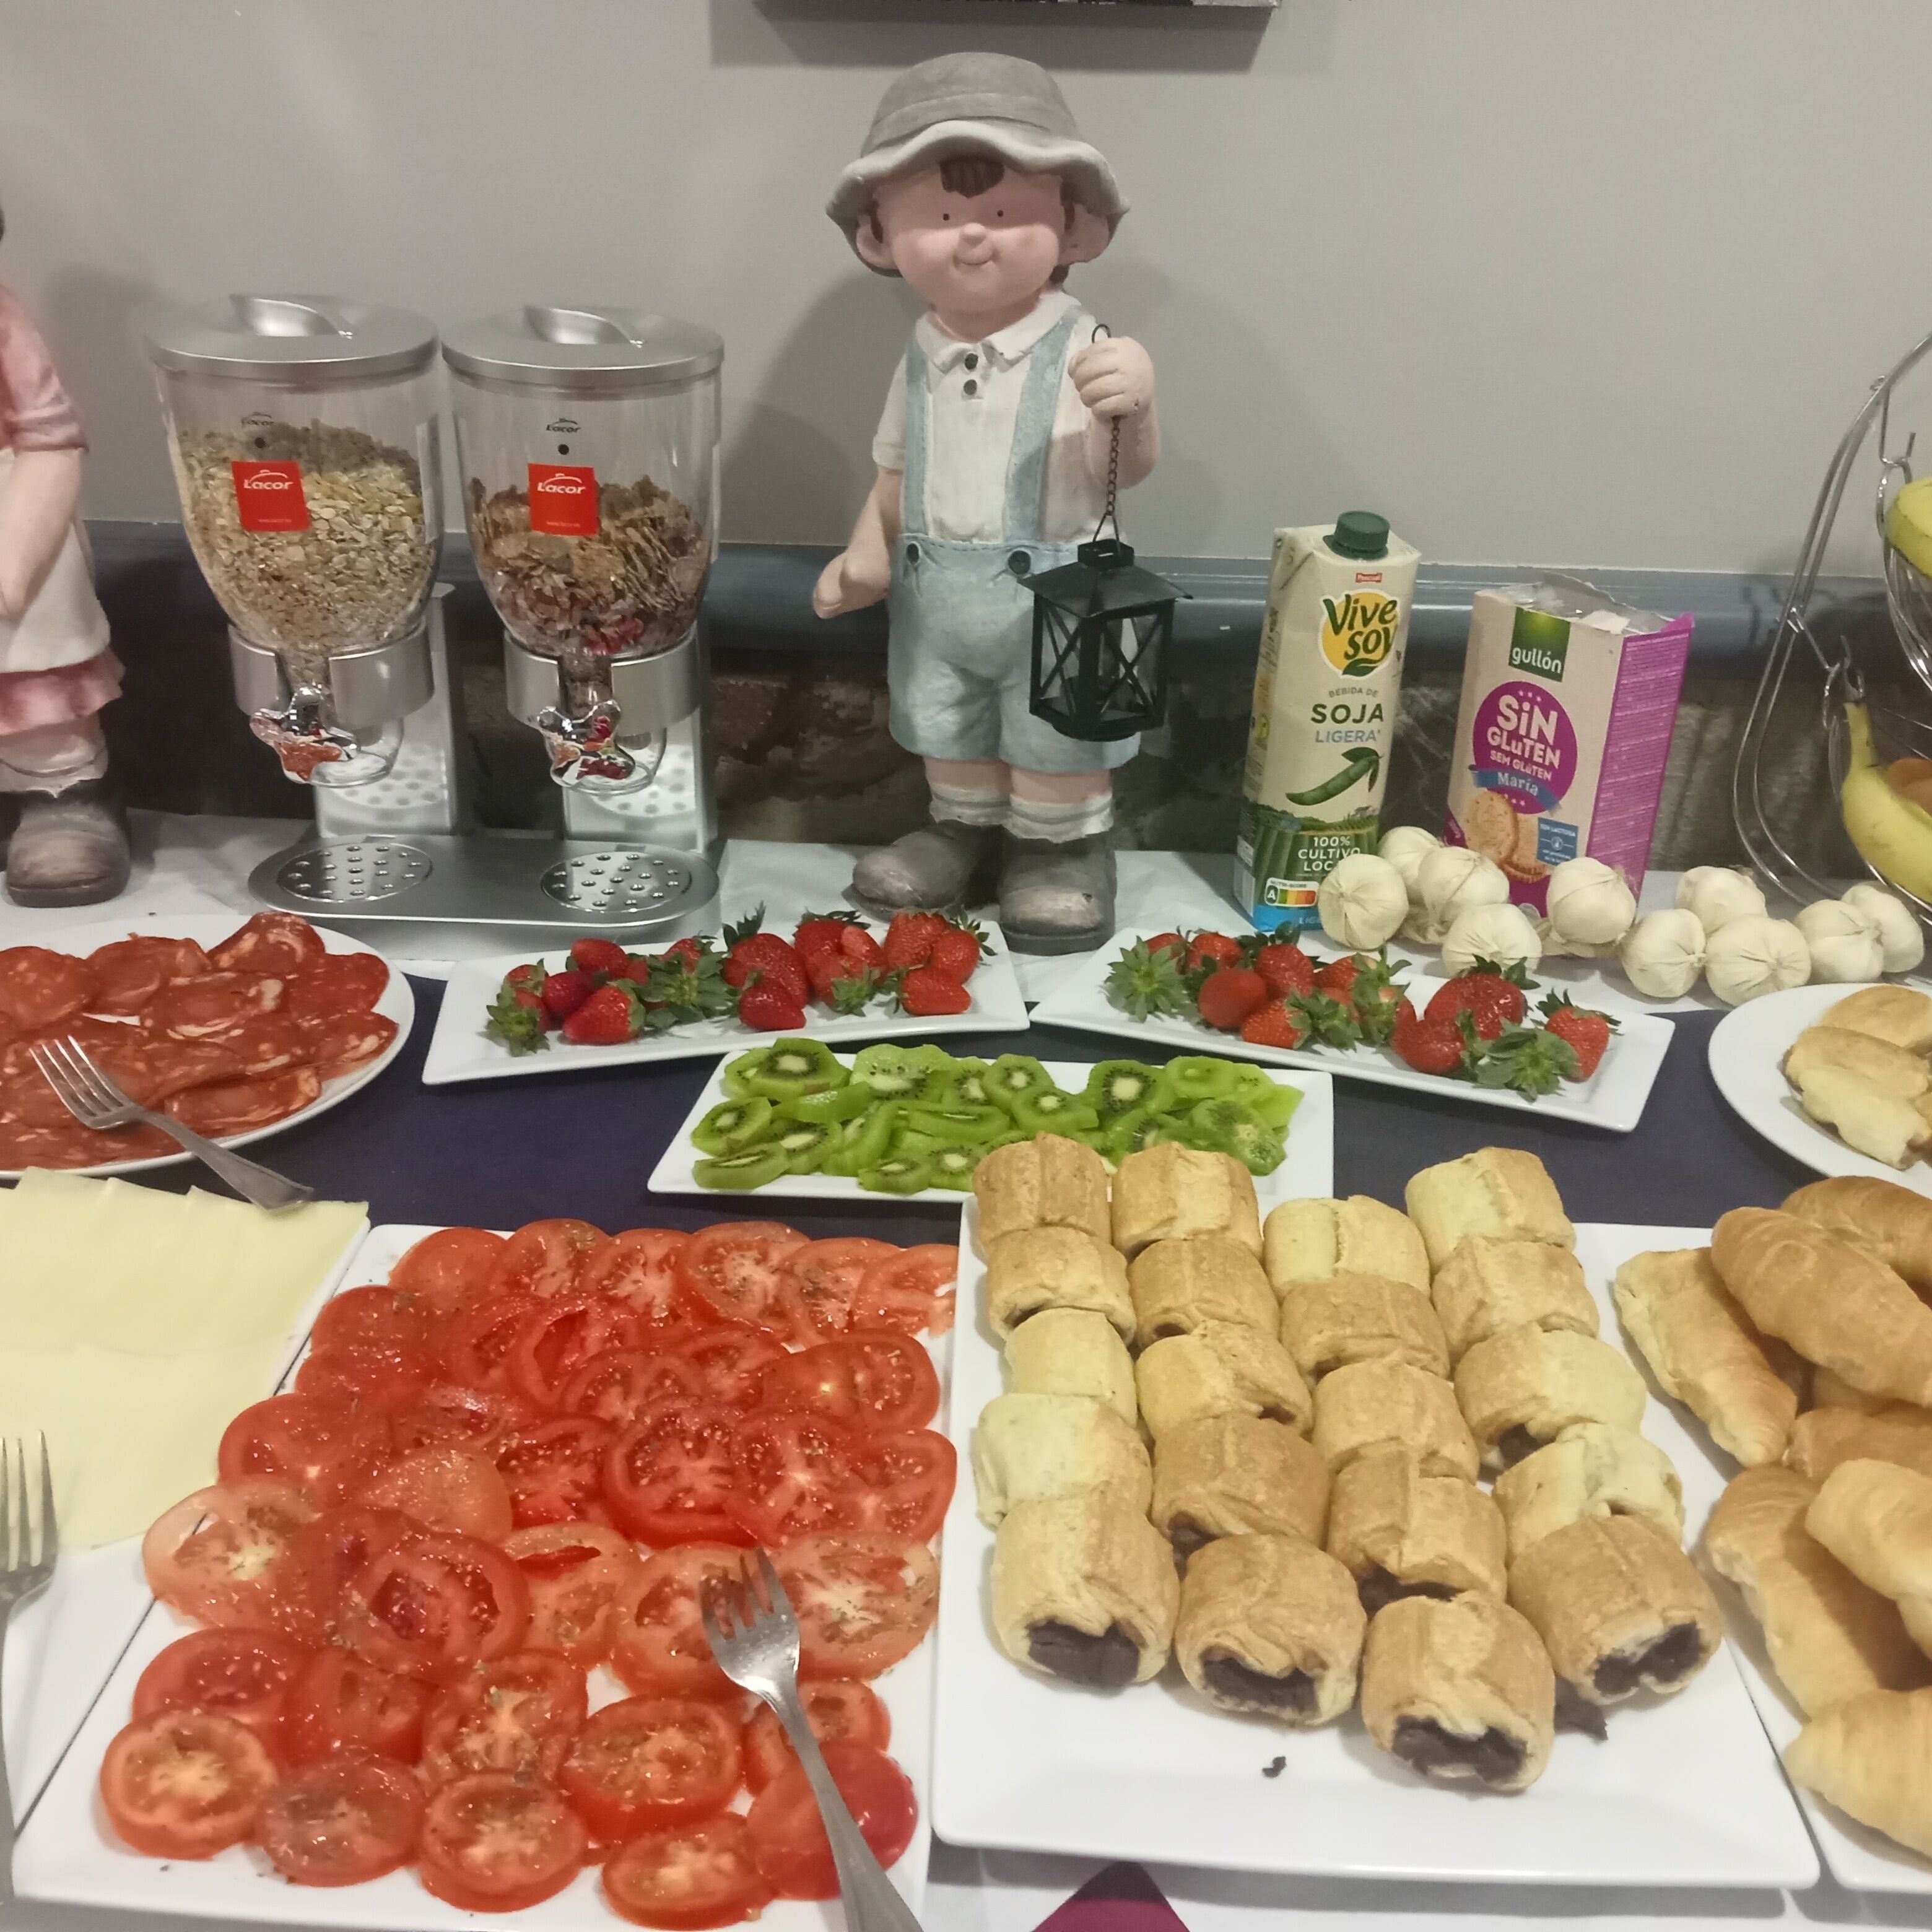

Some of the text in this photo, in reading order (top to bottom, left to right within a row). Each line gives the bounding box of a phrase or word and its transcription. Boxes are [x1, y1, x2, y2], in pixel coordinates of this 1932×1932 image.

[546, 424, 580, 433] Lacor
[244, 479, 294, 490] Lacor
[537, 482, 586, 494] Lacor
[1323, 594, 1398, 636] Vive
[1512, 647, 1562, 674] gullón
[1328, 687, 1379, 698] BEBIDA DE
[1310, 703, 1383, 724] SOJA
[1490, 750, 1511, 766] SEM
[1497, 772, 1539, 796] María
[1313, 836, 1351, 847] 100%
[1303, 861, 1334, 871] LOC
[1267, 889, 1276, 900] A
